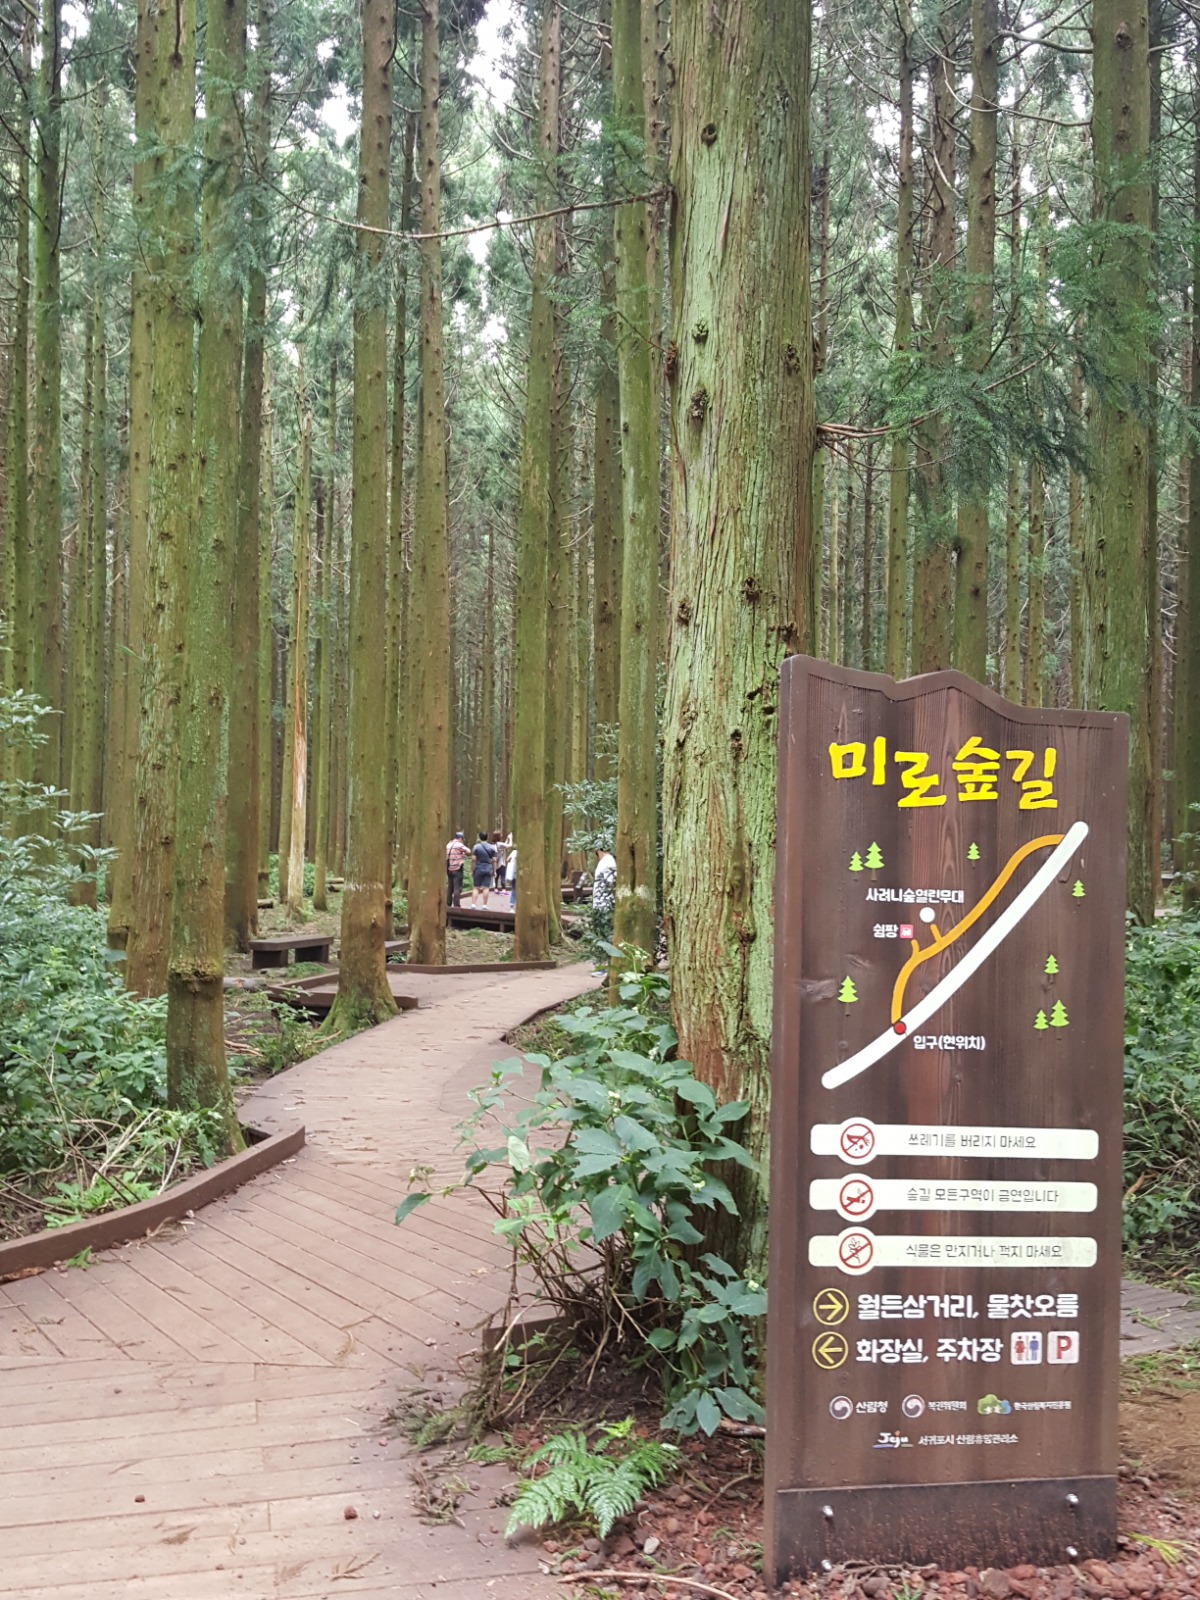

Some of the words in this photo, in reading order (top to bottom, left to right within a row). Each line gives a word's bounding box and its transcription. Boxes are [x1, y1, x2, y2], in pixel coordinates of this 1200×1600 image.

[829, 736, 1059, 809] 미로숲길
[866, 888, 965, 903] 사려니숲열린무대
[873, 923, 898, 938] 쉼팡
[913, 1035, 986, 1052] 입구(현위치)
[908, 1133, 956, 1148] 쓰레기를
[961, 1135, 996, 1148] 버리지
[1000, 1134, 1036, 1149] 마세요
[907, 1187, 931, 1201] 숲길
[998, 1189, 1059, 1203] 금연입니다
[906, 1244, 941, 1258] 식물은
[945, 1245, 995, 1258] 만지거나
[1026, 1245, 1063, 1258] 마세요
[857, 1294, 979, 1319] 월든삼거리,
[987, 1293, 1079, 1318] 물찻오름
[855, 1338, 929, 1363] 화장실,
[936, 1337, 1003, 1363] 주차장
[855, 1401, 888, 1414] 산림청
[878, 1432, 909, 1448] Jeju
[918, 1434, 955, 1445] 서귀포시
